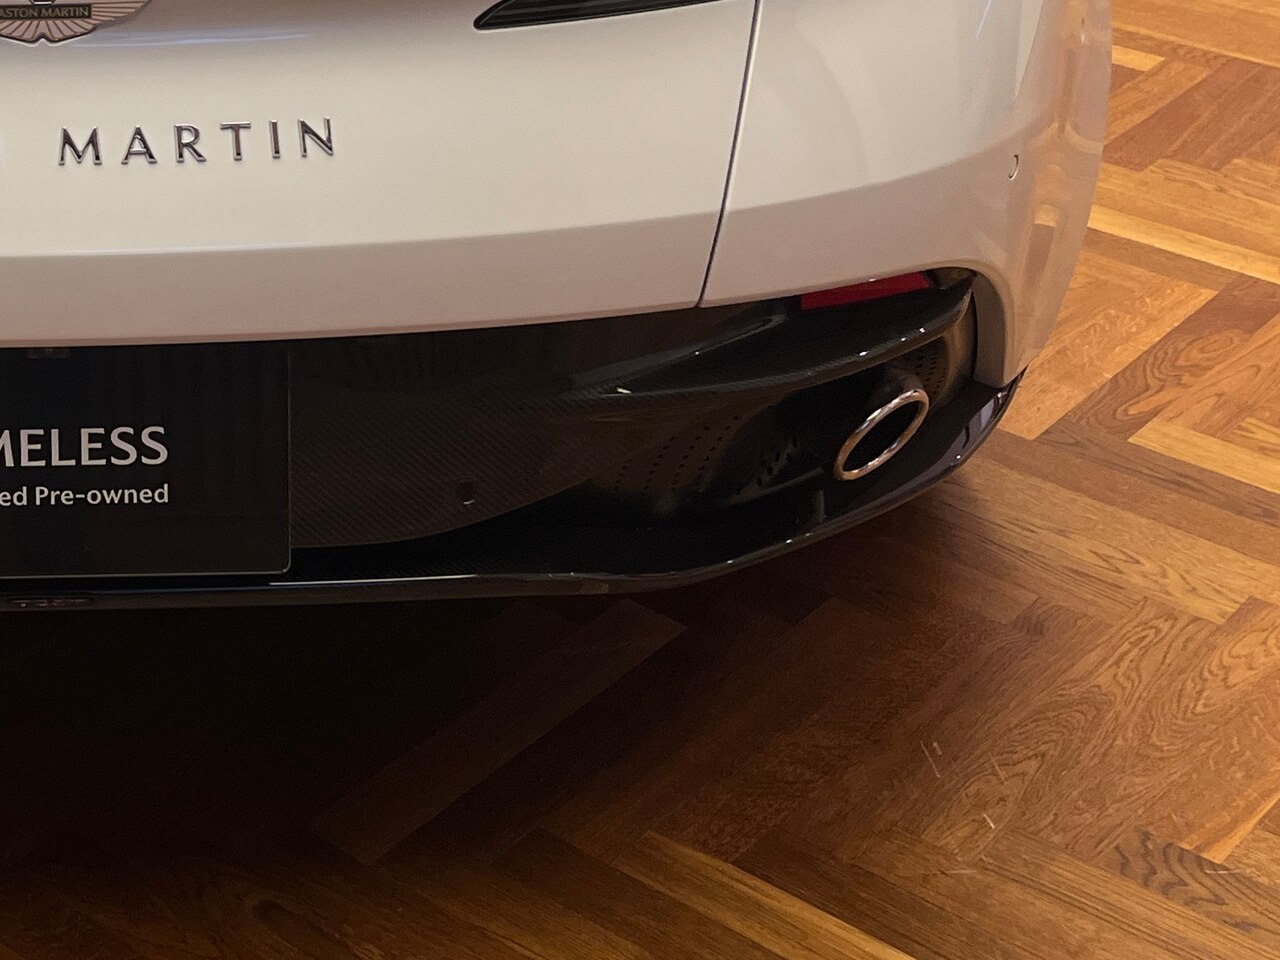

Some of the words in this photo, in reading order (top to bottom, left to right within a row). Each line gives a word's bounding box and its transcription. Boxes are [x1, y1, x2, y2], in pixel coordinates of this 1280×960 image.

[41, 6, 89, 18] MARTIN
[57, 118, 335, 166] MARTIN
[35, 484, 169, 506] Pre-owned
